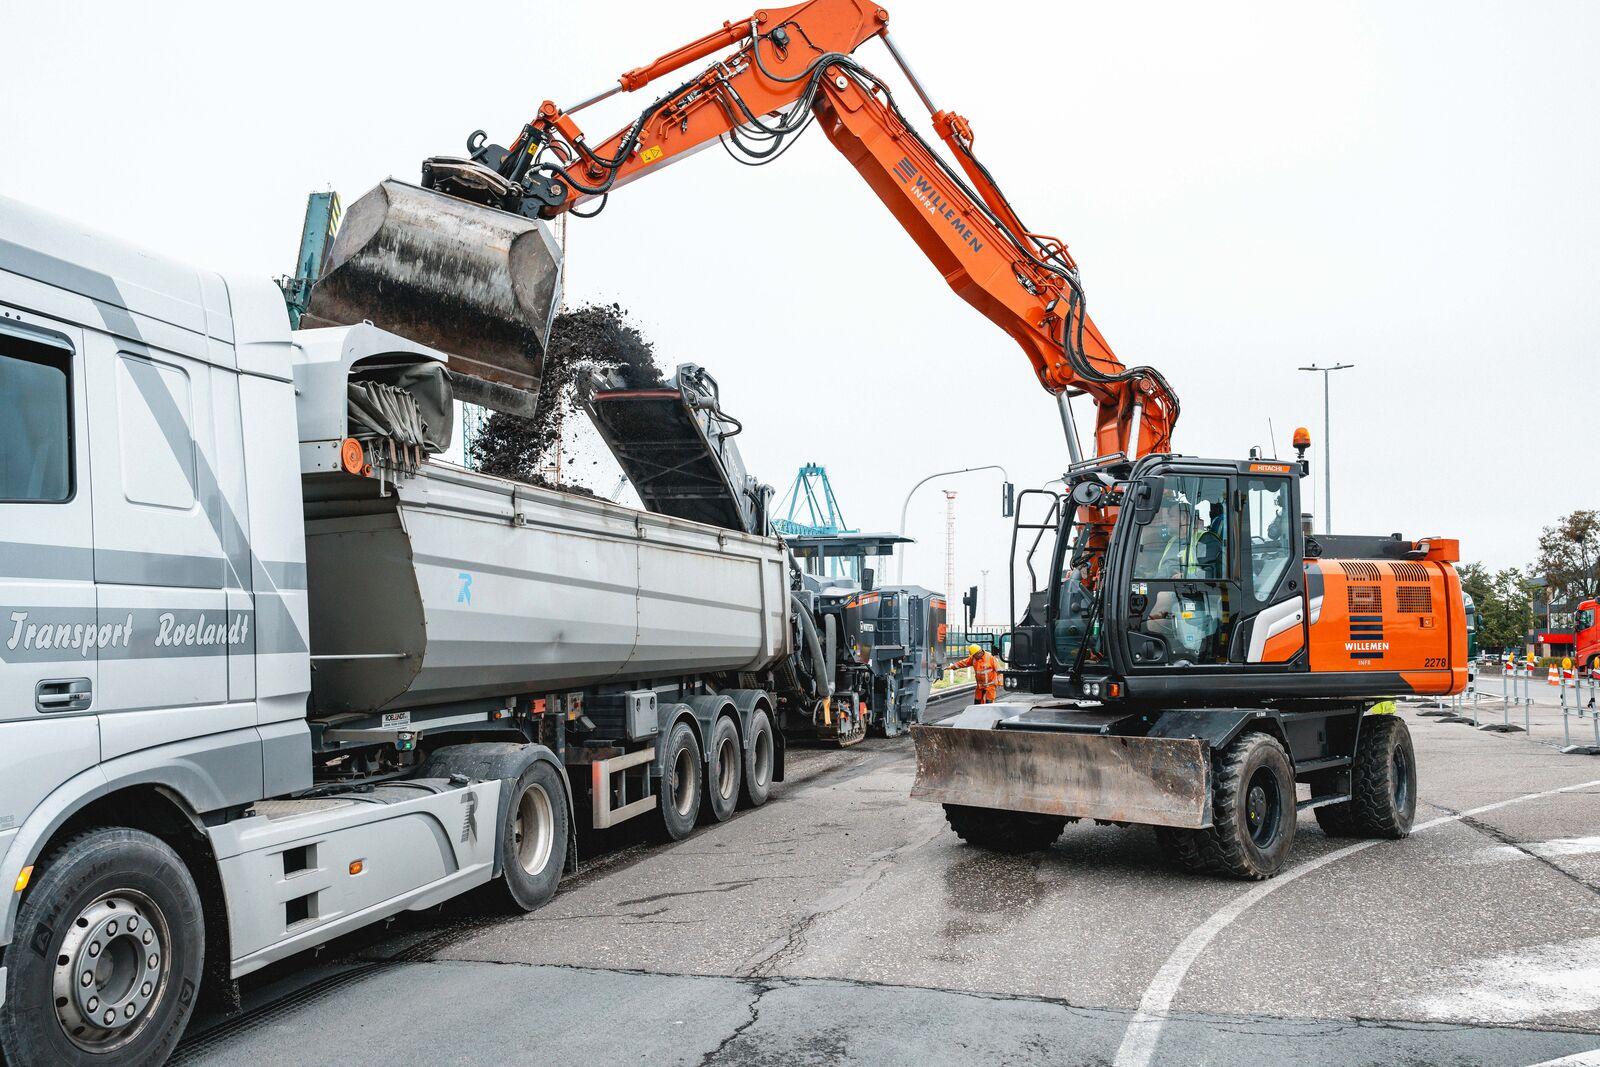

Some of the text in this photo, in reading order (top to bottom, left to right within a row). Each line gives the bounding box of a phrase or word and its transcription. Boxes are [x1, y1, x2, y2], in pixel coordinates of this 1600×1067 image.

[910, 185, 937, 215] INFRA
[915, 175, 984, 253] WILLEMEN
[1257, 465, 1283, 473] HITACHI
[6, 611, 249, 657] Transport Roelandt
[1344, 642, 1390, 651] WILLEMEN
[1424, 658, 1447, 668] 2278
